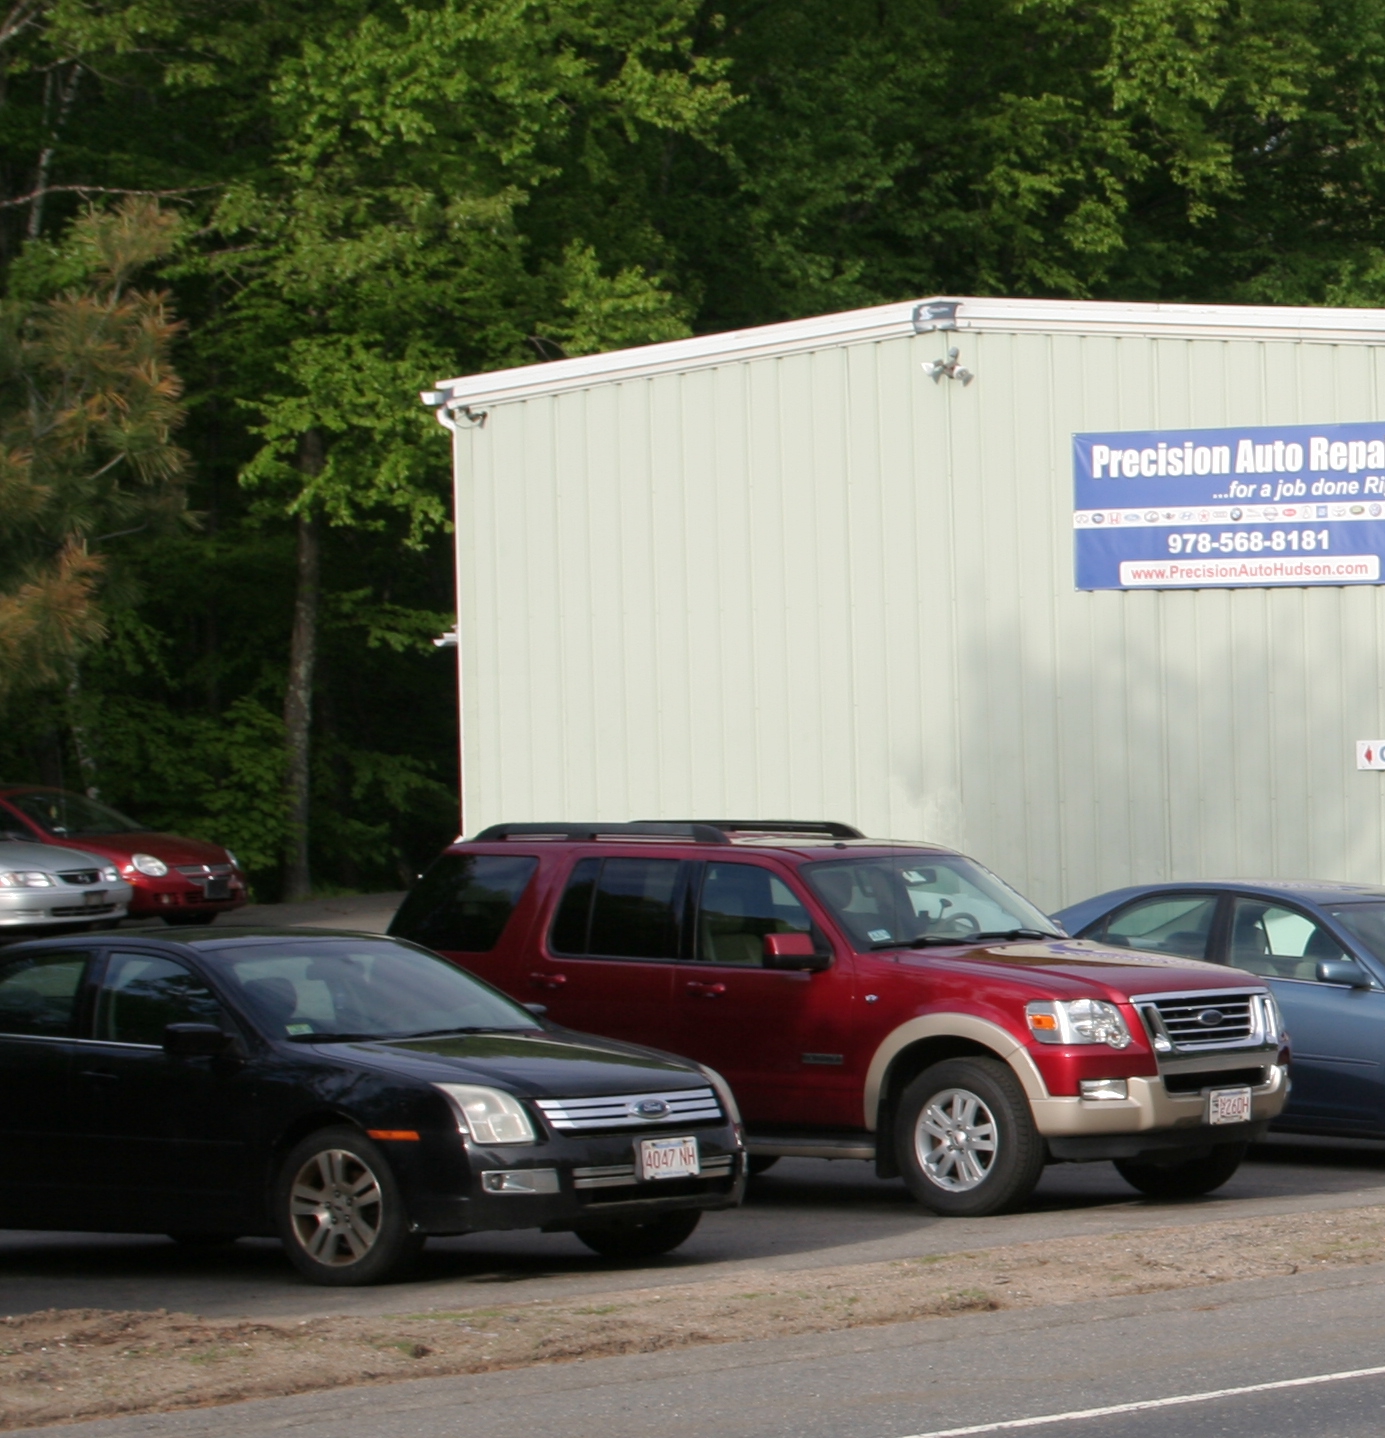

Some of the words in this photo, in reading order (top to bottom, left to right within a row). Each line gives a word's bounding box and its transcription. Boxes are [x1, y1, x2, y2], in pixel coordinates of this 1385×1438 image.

[1092, 441, 1231, 478] Precision
[1235, 439, 1302, 474] Auto
[1260, 484, 1271, 498] a
[1273, 479, 1306, 501] job
[1311, 477, 1358, 496] done
[1168, 529, 1329, 554] 978-568-8181
[1131, 562, 1369, 580] www.PrecisionAutoHudson.com
[646, 1149, 675, 1168] 4047
[679, 1146, 696, 1166] NH
